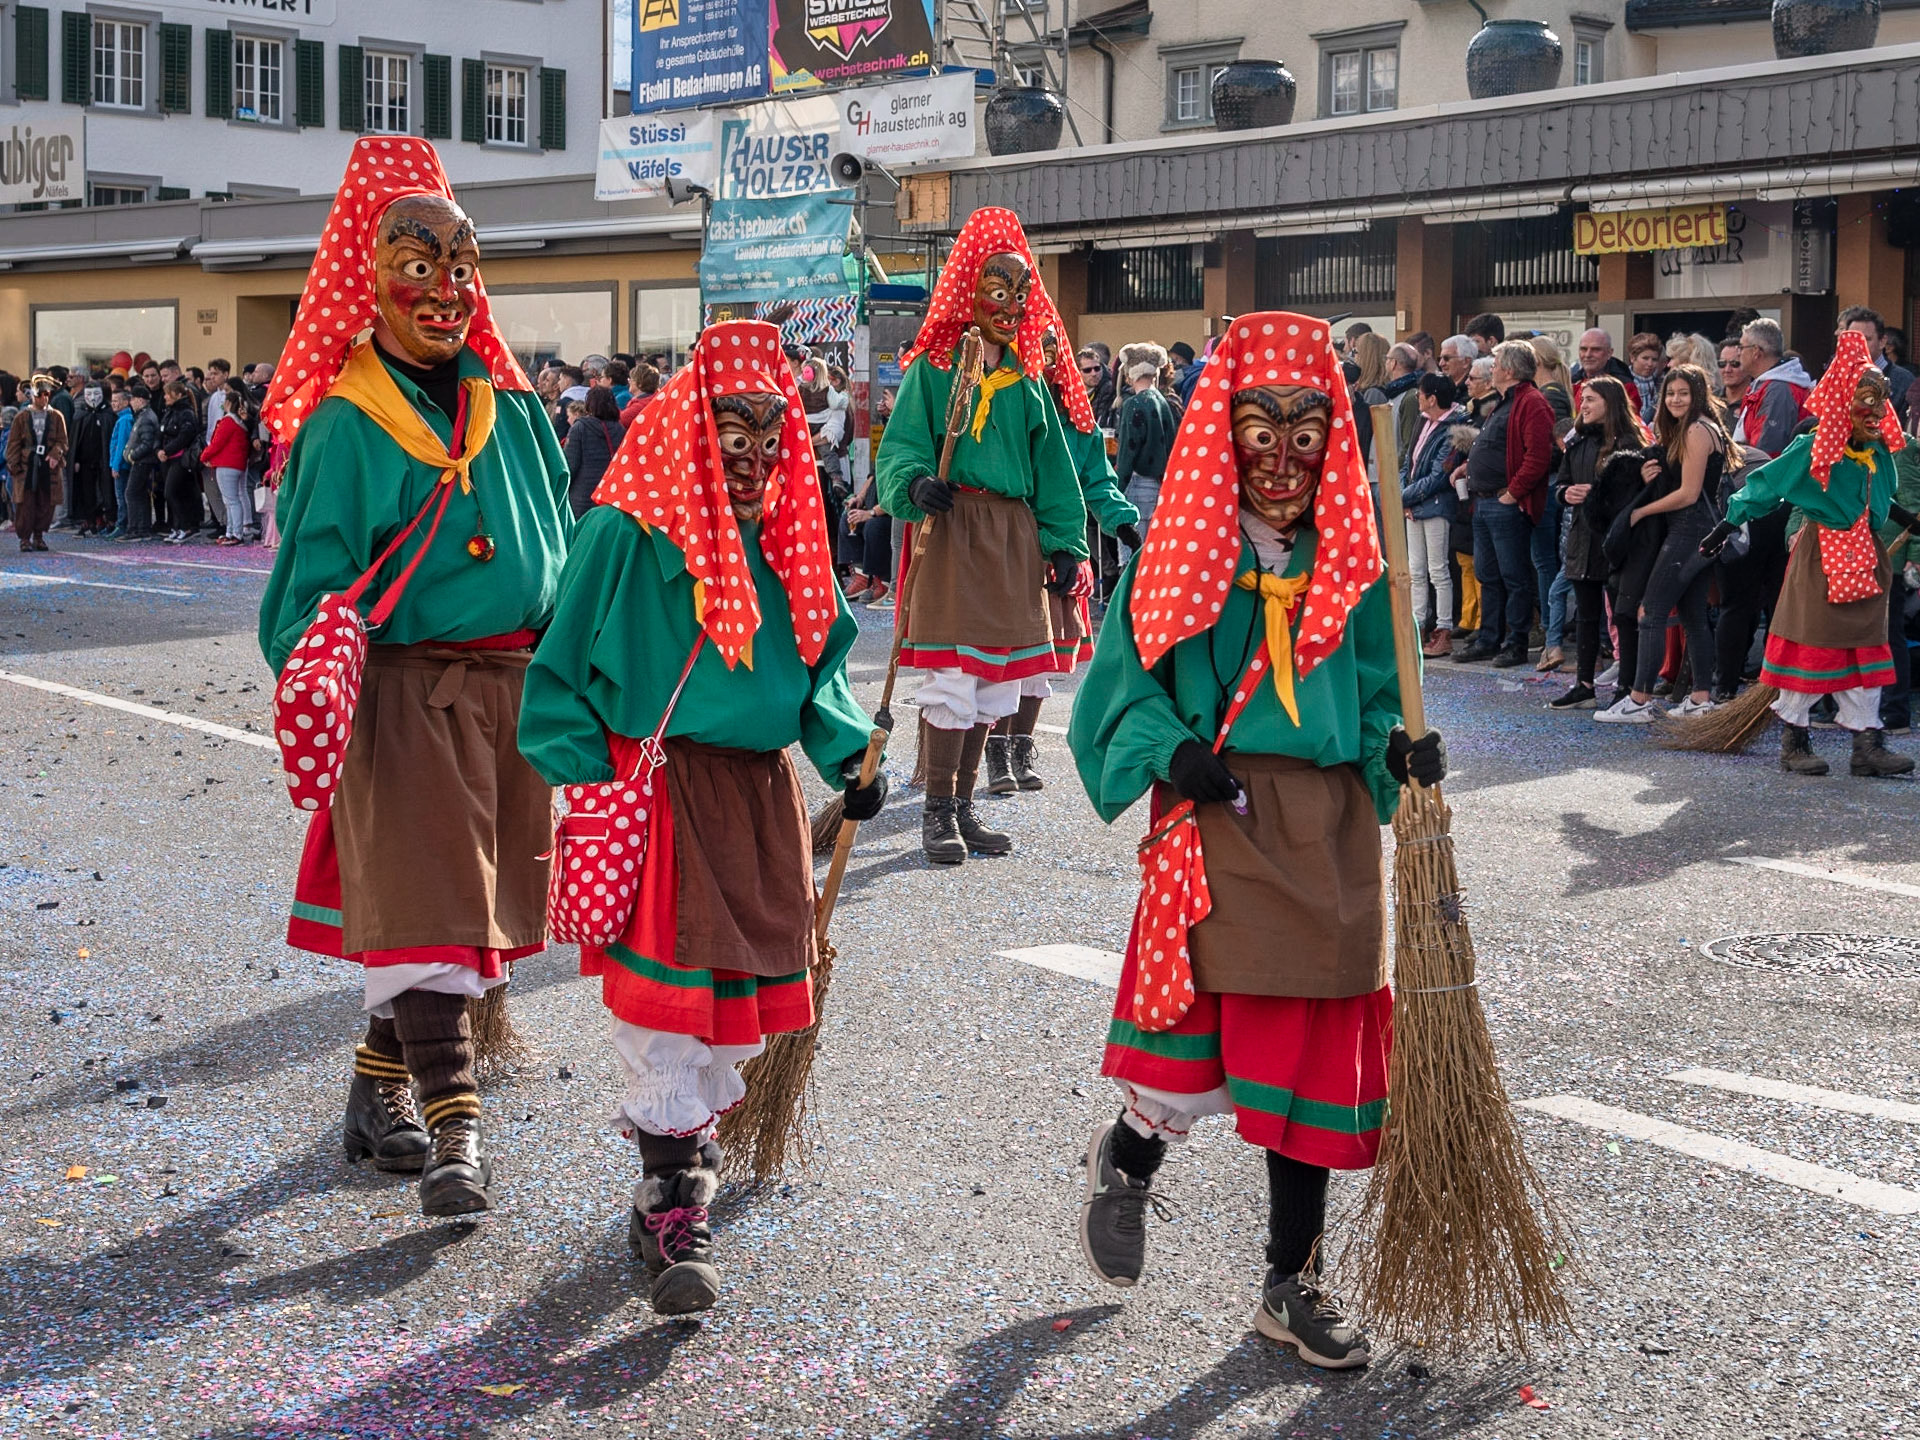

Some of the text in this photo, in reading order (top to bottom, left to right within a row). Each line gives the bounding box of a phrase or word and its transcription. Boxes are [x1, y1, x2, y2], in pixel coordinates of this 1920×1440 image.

[809, 5, 887, 27] WERBETECHNIK
[671, 29, 726, 49] Ansprechpartner
[665, 53, 696, 70] gesamte
[697, 44, 744, 63] Gebäudehülle
[639, 64, 762, 104] Fischli Bedachungen AG
[890, 94, 932, 115] glarner
[629, 122, 686, 146] Stüssi
[873, 111, 967, 134] haustechnik ag
[731, 133, 830, 171] HAUSER
[866, 138, 940, 157] glarner-haustechnik.ch
[628, 158, 683, 180] Näfels
[46, 186, 69, 198] Näfels
[733, 163, 832, 199] HOLZBA
[1577, 205, 1722, 249] Dekoriert
[830, 239, 843, 254] AG
[1800, 239, 1811, 287] BISTRO
